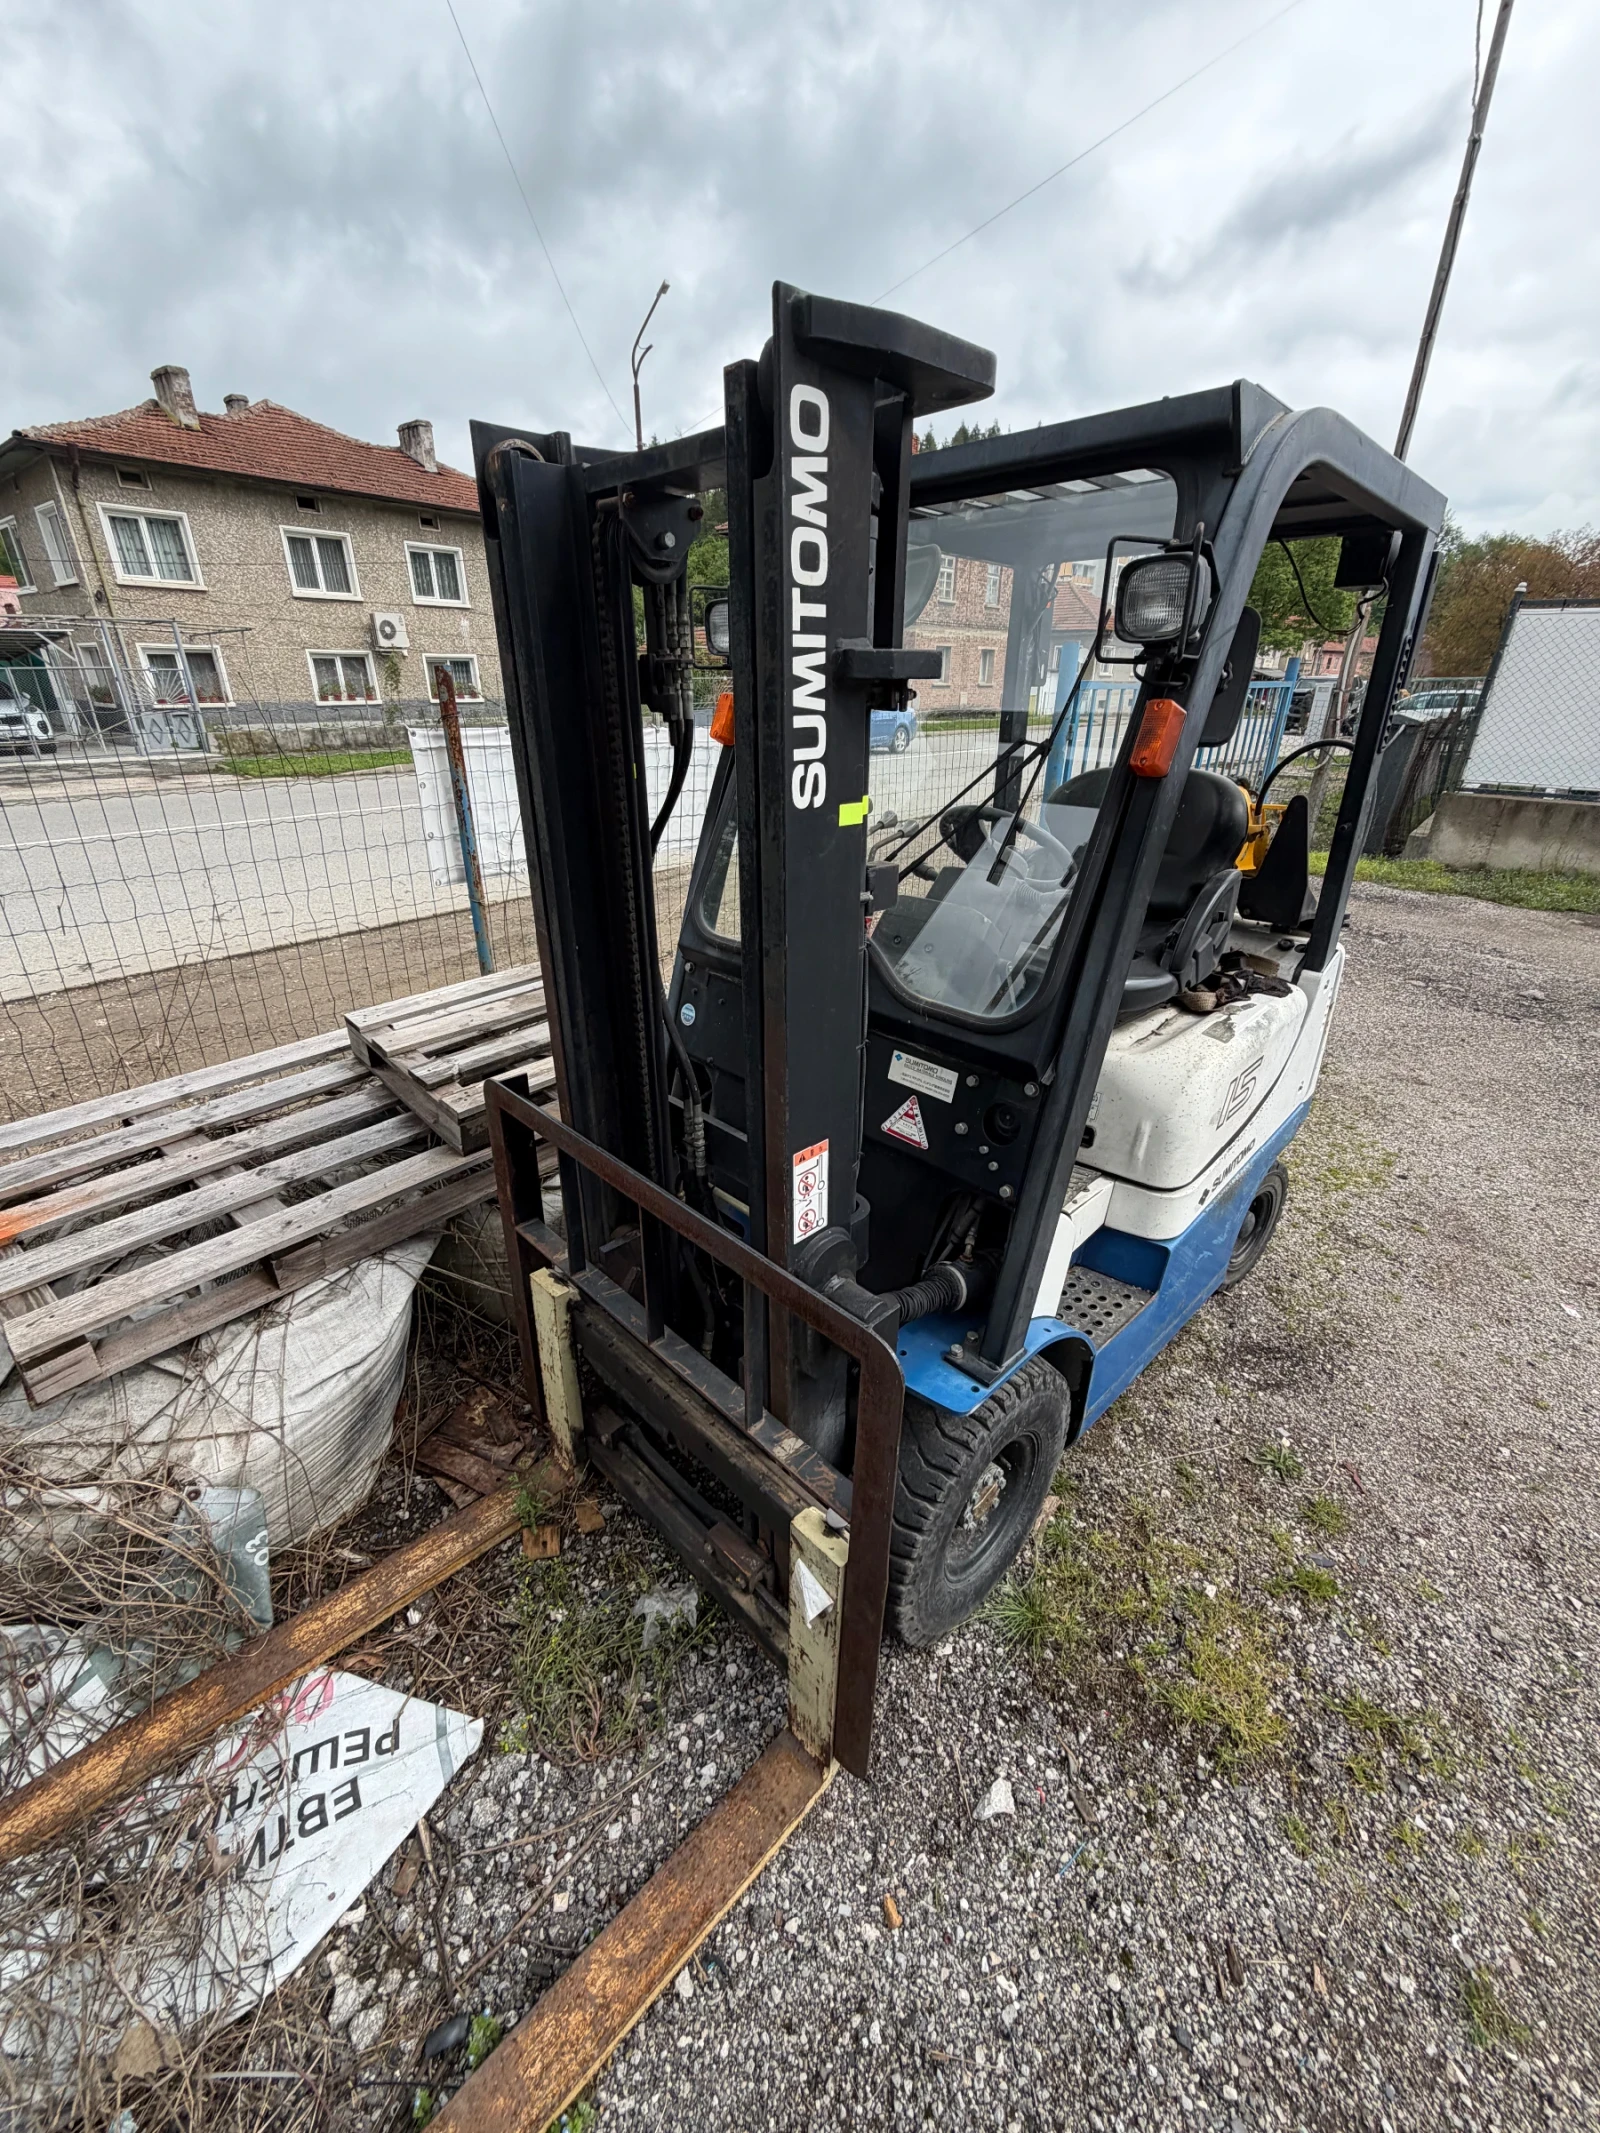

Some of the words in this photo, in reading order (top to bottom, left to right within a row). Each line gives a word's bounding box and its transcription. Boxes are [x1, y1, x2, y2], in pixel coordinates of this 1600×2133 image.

[790, 384, 829, 809] SUMITOMO
[905, 1058, 938, 1074] SUMITOMO
[1216, 1055, 1264, 1130] 15
[1212, 1138, 1256, 1192] SUMITOMO
